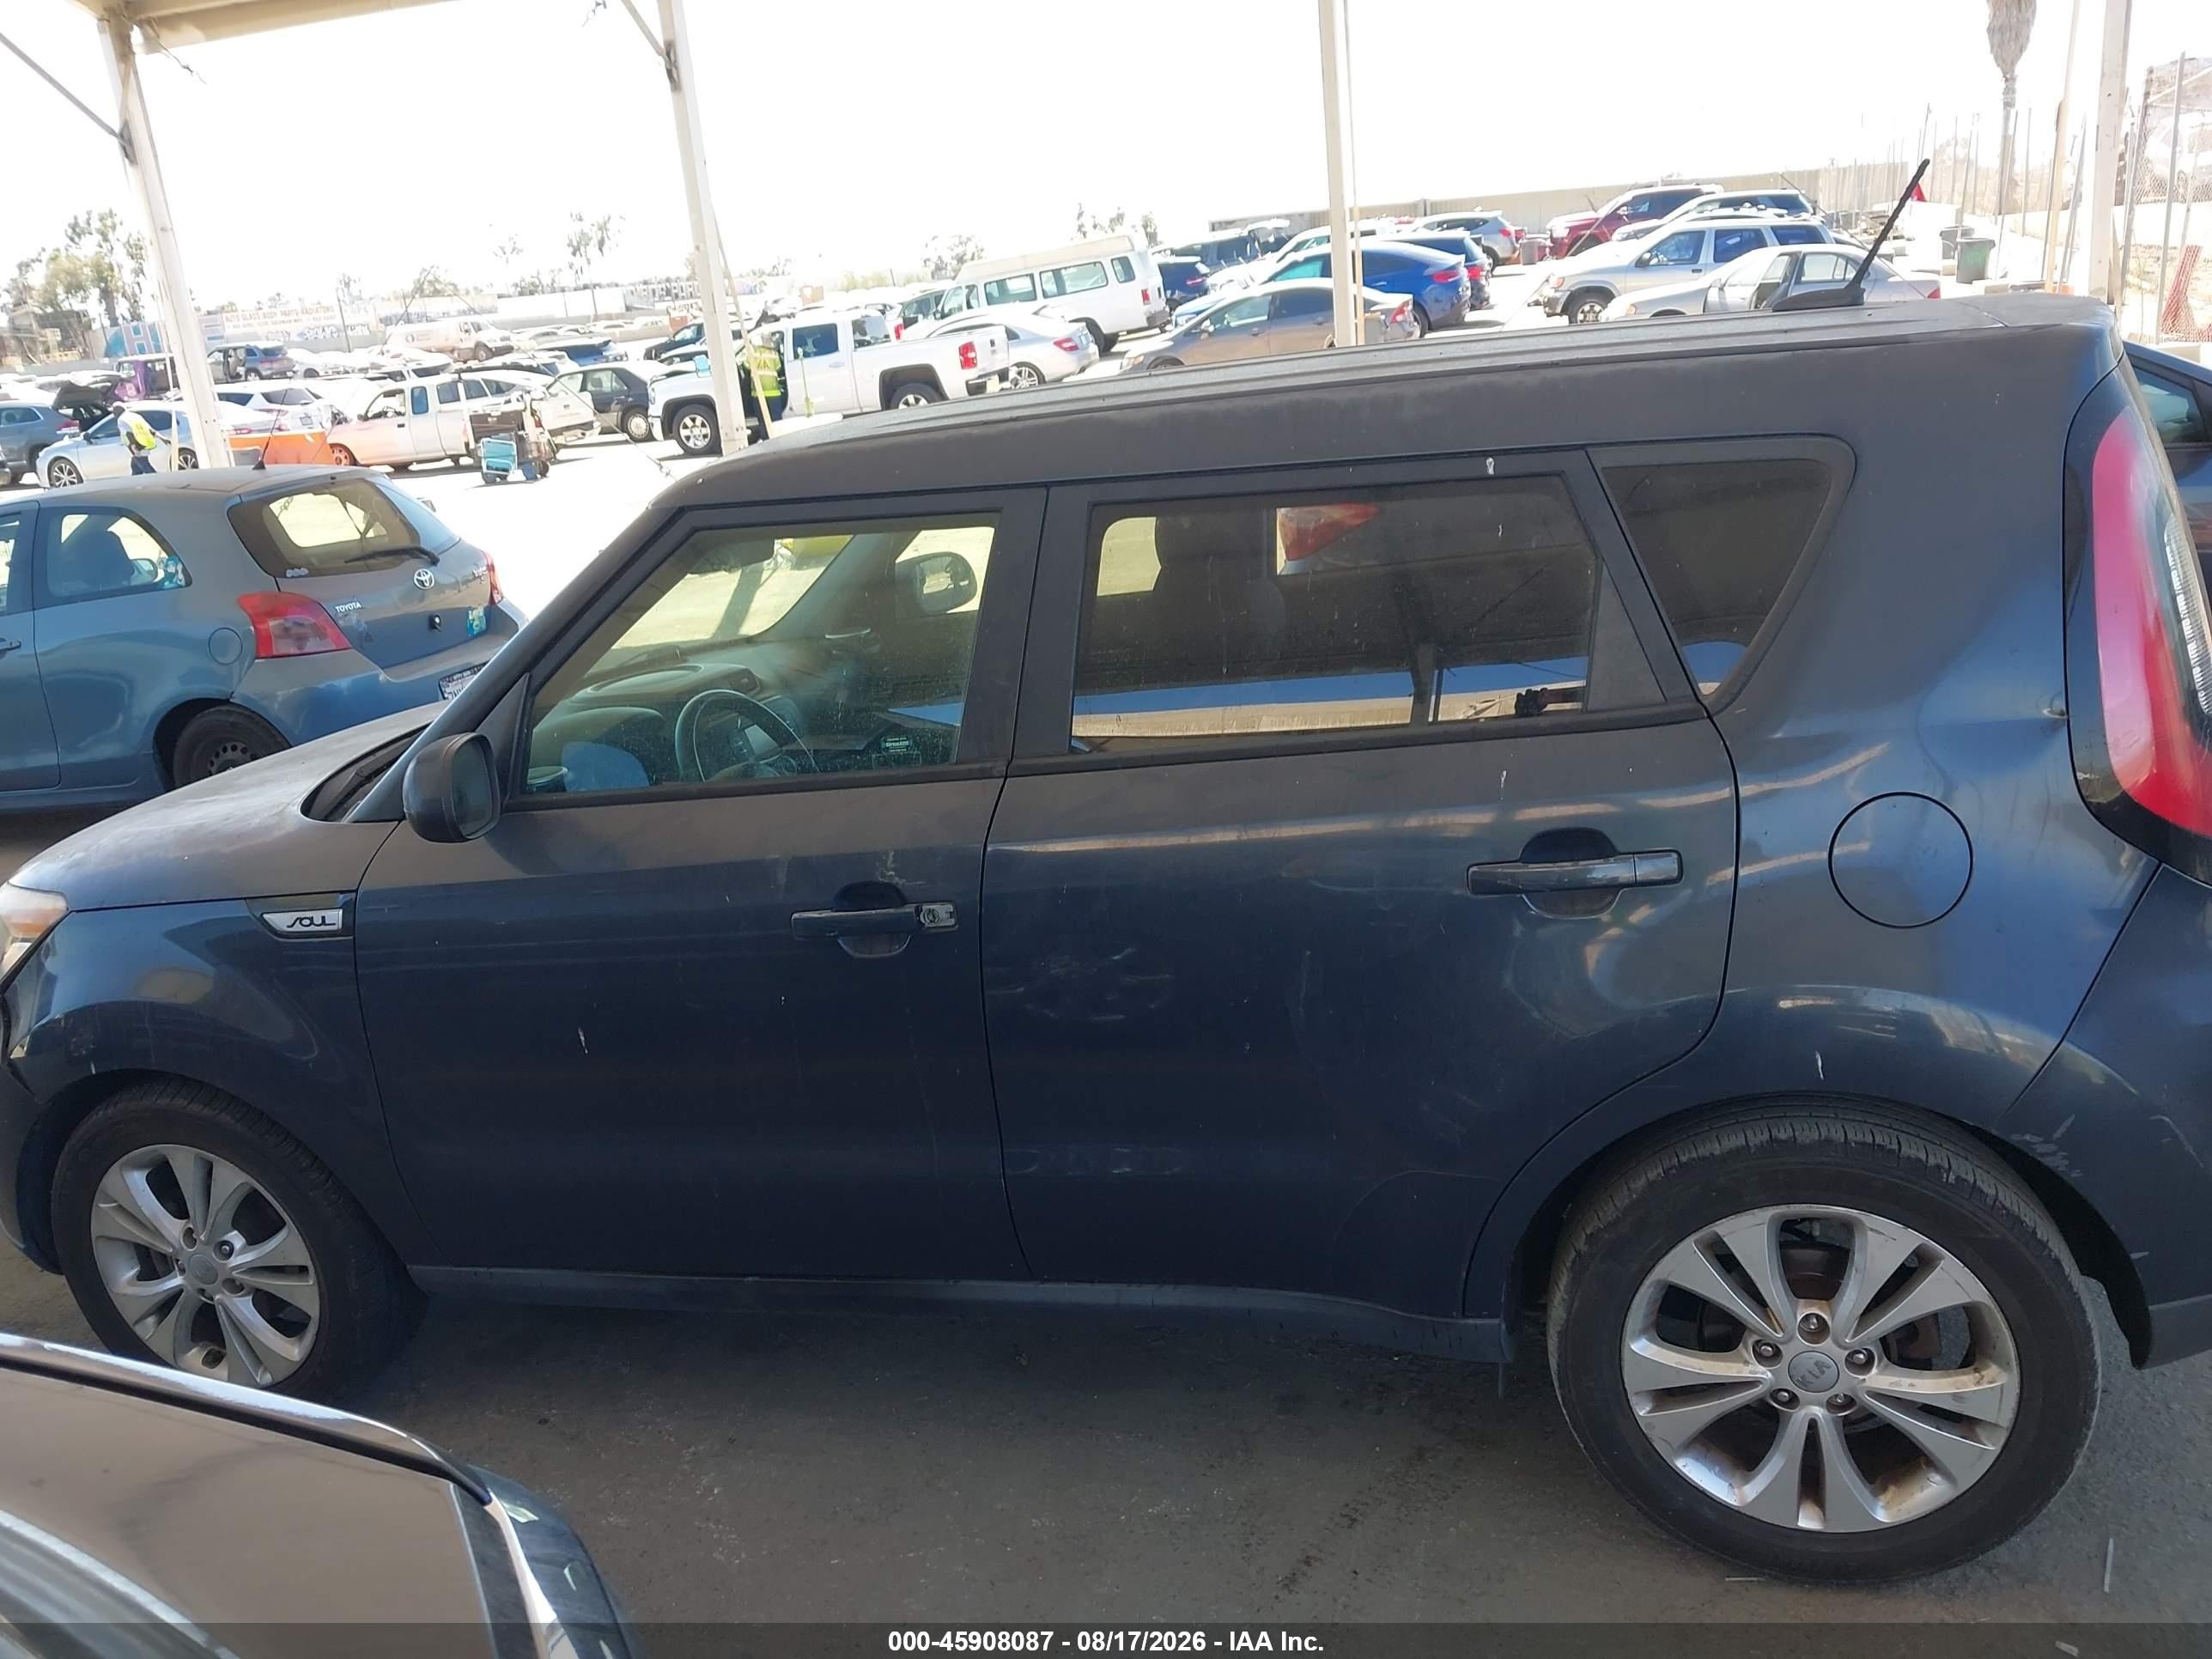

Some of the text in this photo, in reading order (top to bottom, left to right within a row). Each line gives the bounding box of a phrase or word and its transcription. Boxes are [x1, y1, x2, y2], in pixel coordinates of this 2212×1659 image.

[335, 600, 362, 613] TOYOTA
[286, 915, 337, 928] SOUL
[1795, 1359, 1832, 1388] KIA
